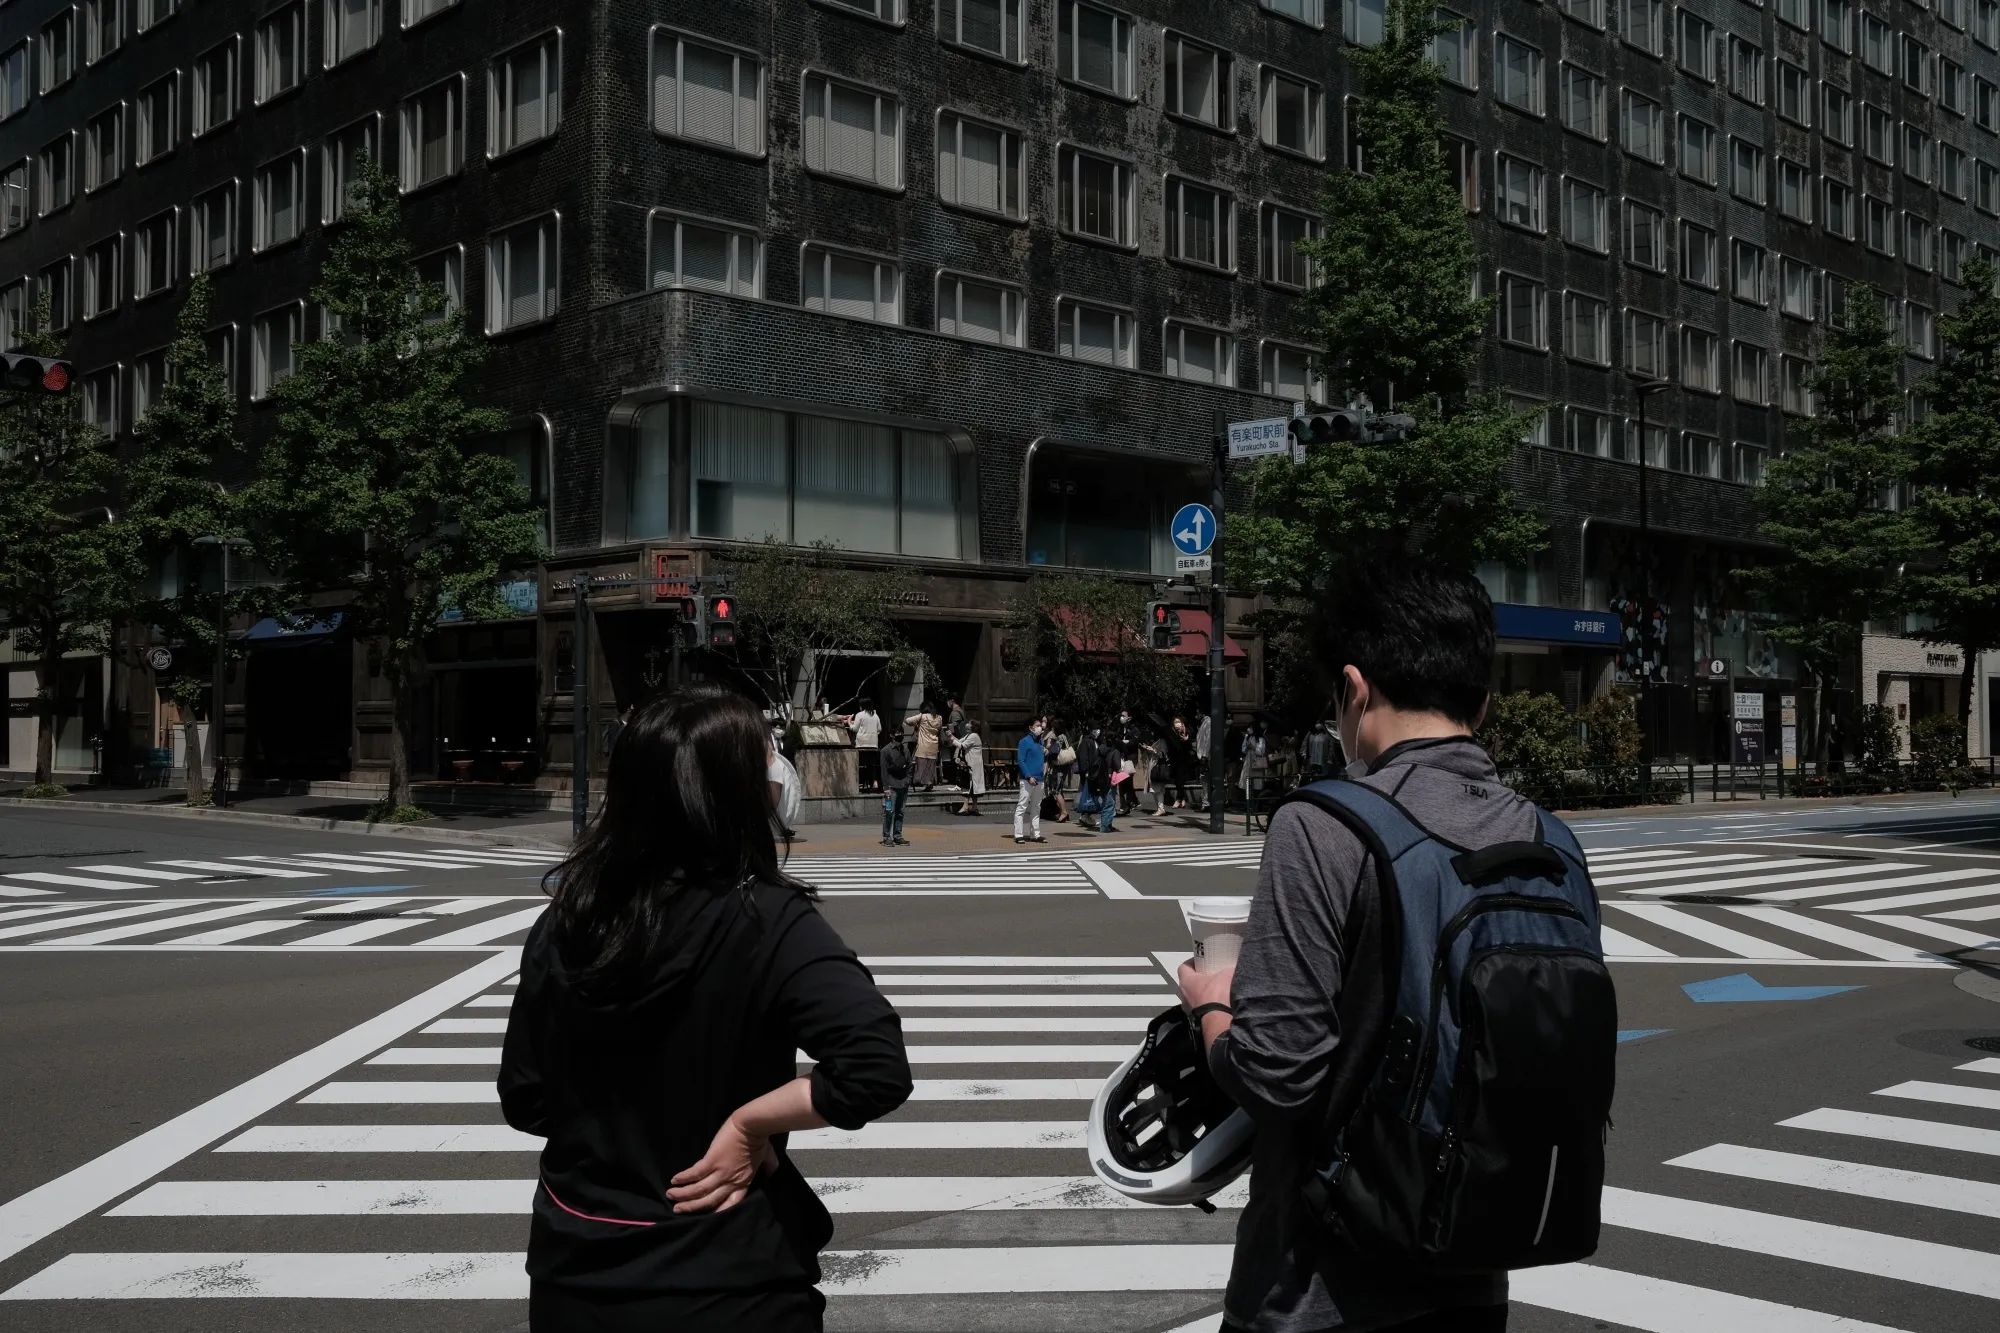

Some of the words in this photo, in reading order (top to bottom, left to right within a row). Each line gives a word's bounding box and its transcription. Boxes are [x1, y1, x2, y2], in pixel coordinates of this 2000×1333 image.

[1231, 423, 1285, 443] 有楽町駅前
[1236, 442, 1267, 452] Yurakucho
[1268, 441, 1281, 449] Sta.
[1178, 559, 1209, 568] 自転車を除く
[1574, 620, 1606, 634] みずほ銀行
[1460, 783, 1488, 801] TSLA
